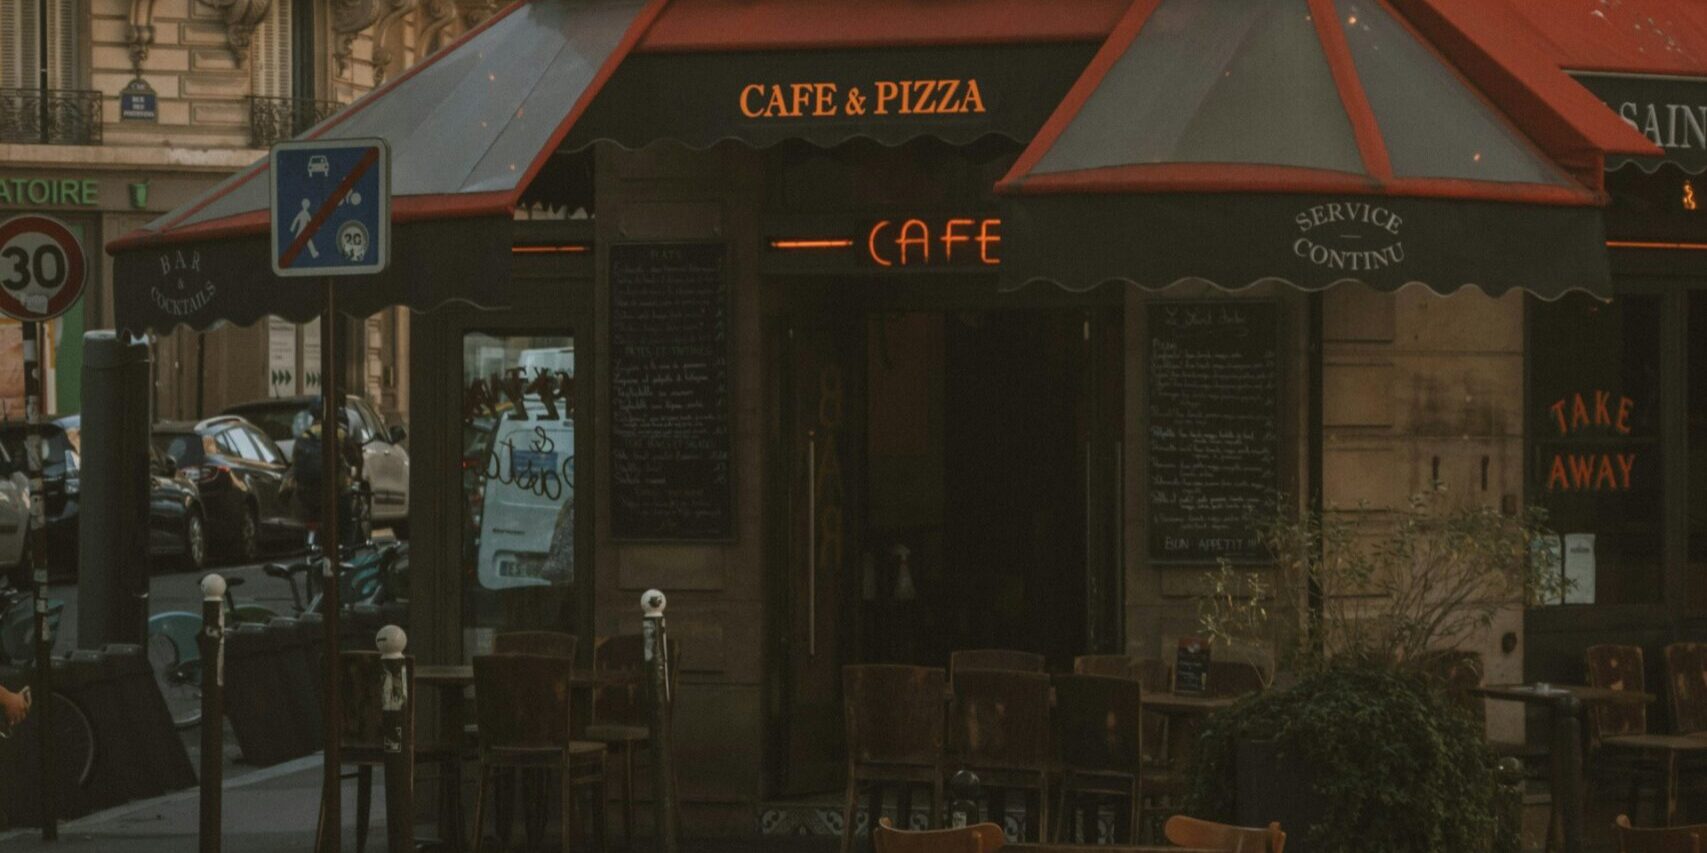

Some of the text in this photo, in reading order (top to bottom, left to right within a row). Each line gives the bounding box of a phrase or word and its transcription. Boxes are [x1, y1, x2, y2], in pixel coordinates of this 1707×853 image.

[740, 79, 985, 118] CAFE & PIZZA
[0, 178, 98, 206] ATOIRE
[1295, 202, 1404, 234] SERVICE
[868, 218, 1001, 267] CAFE
[1293, 238, 1406, 272] CONTINU
[1, 244, 66, 291] 30
[160, 250, 200, 275] BAR
[151, 280, 216, 316] COCKTAILS
[177, 279, 185, 289] &
[1548, 389, 1635, 435] TAKE
[1547, 453, 1637, 491] AWAY
[1164, 536, 1190, 550] BON
